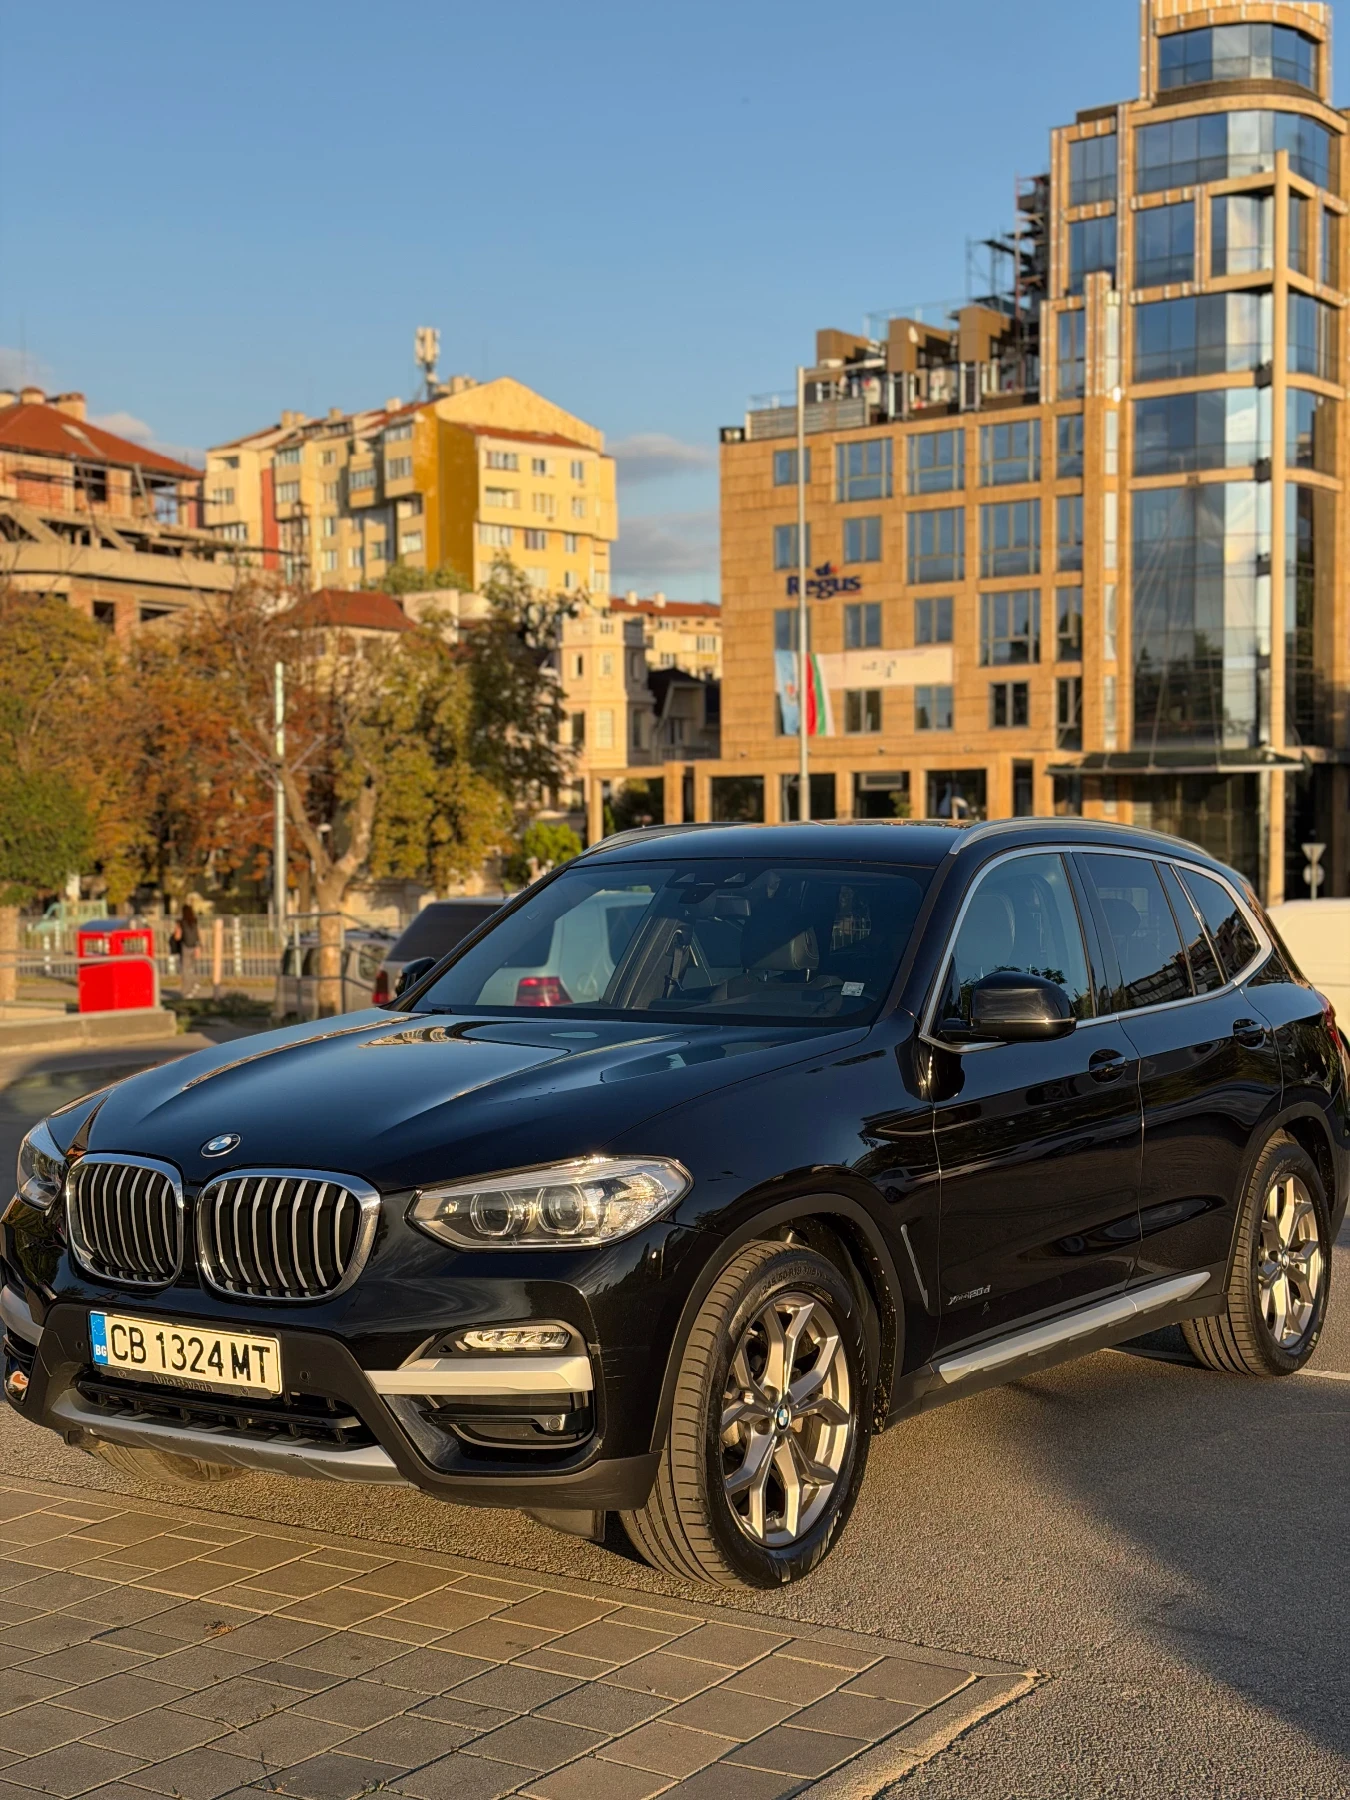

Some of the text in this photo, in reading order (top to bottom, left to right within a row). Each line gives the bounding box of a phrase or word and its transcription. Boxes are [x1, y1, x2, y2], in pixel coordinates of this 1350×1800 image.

[787, 575, 861, 599] Regus
[95, 1344, 107, 1357] BG
[111, 1324, 270, 1383] CB 1324 MT
